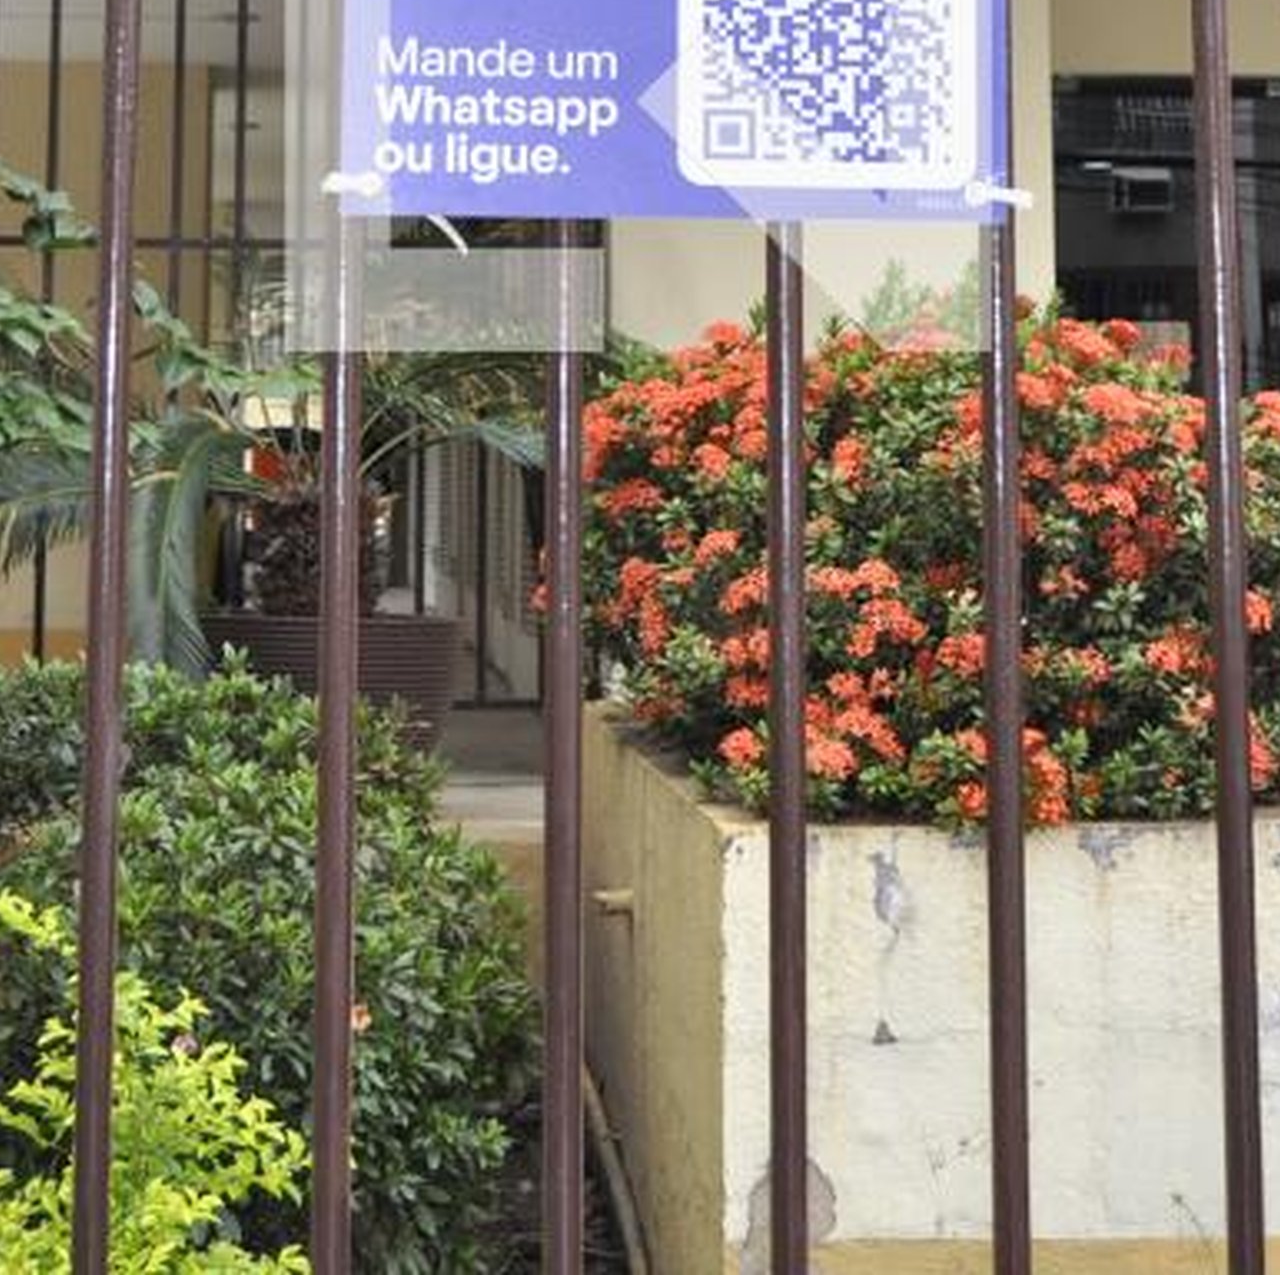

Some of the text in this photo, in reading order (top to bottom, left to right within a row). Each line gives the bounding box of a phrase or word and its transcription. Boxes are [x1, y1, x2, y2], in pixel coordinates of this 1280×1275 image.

[377, 35, 618, 79] Mande um
[375, 83, 619, 137] Whatsapp
[374, 131, 571, 184] ou ligue.
